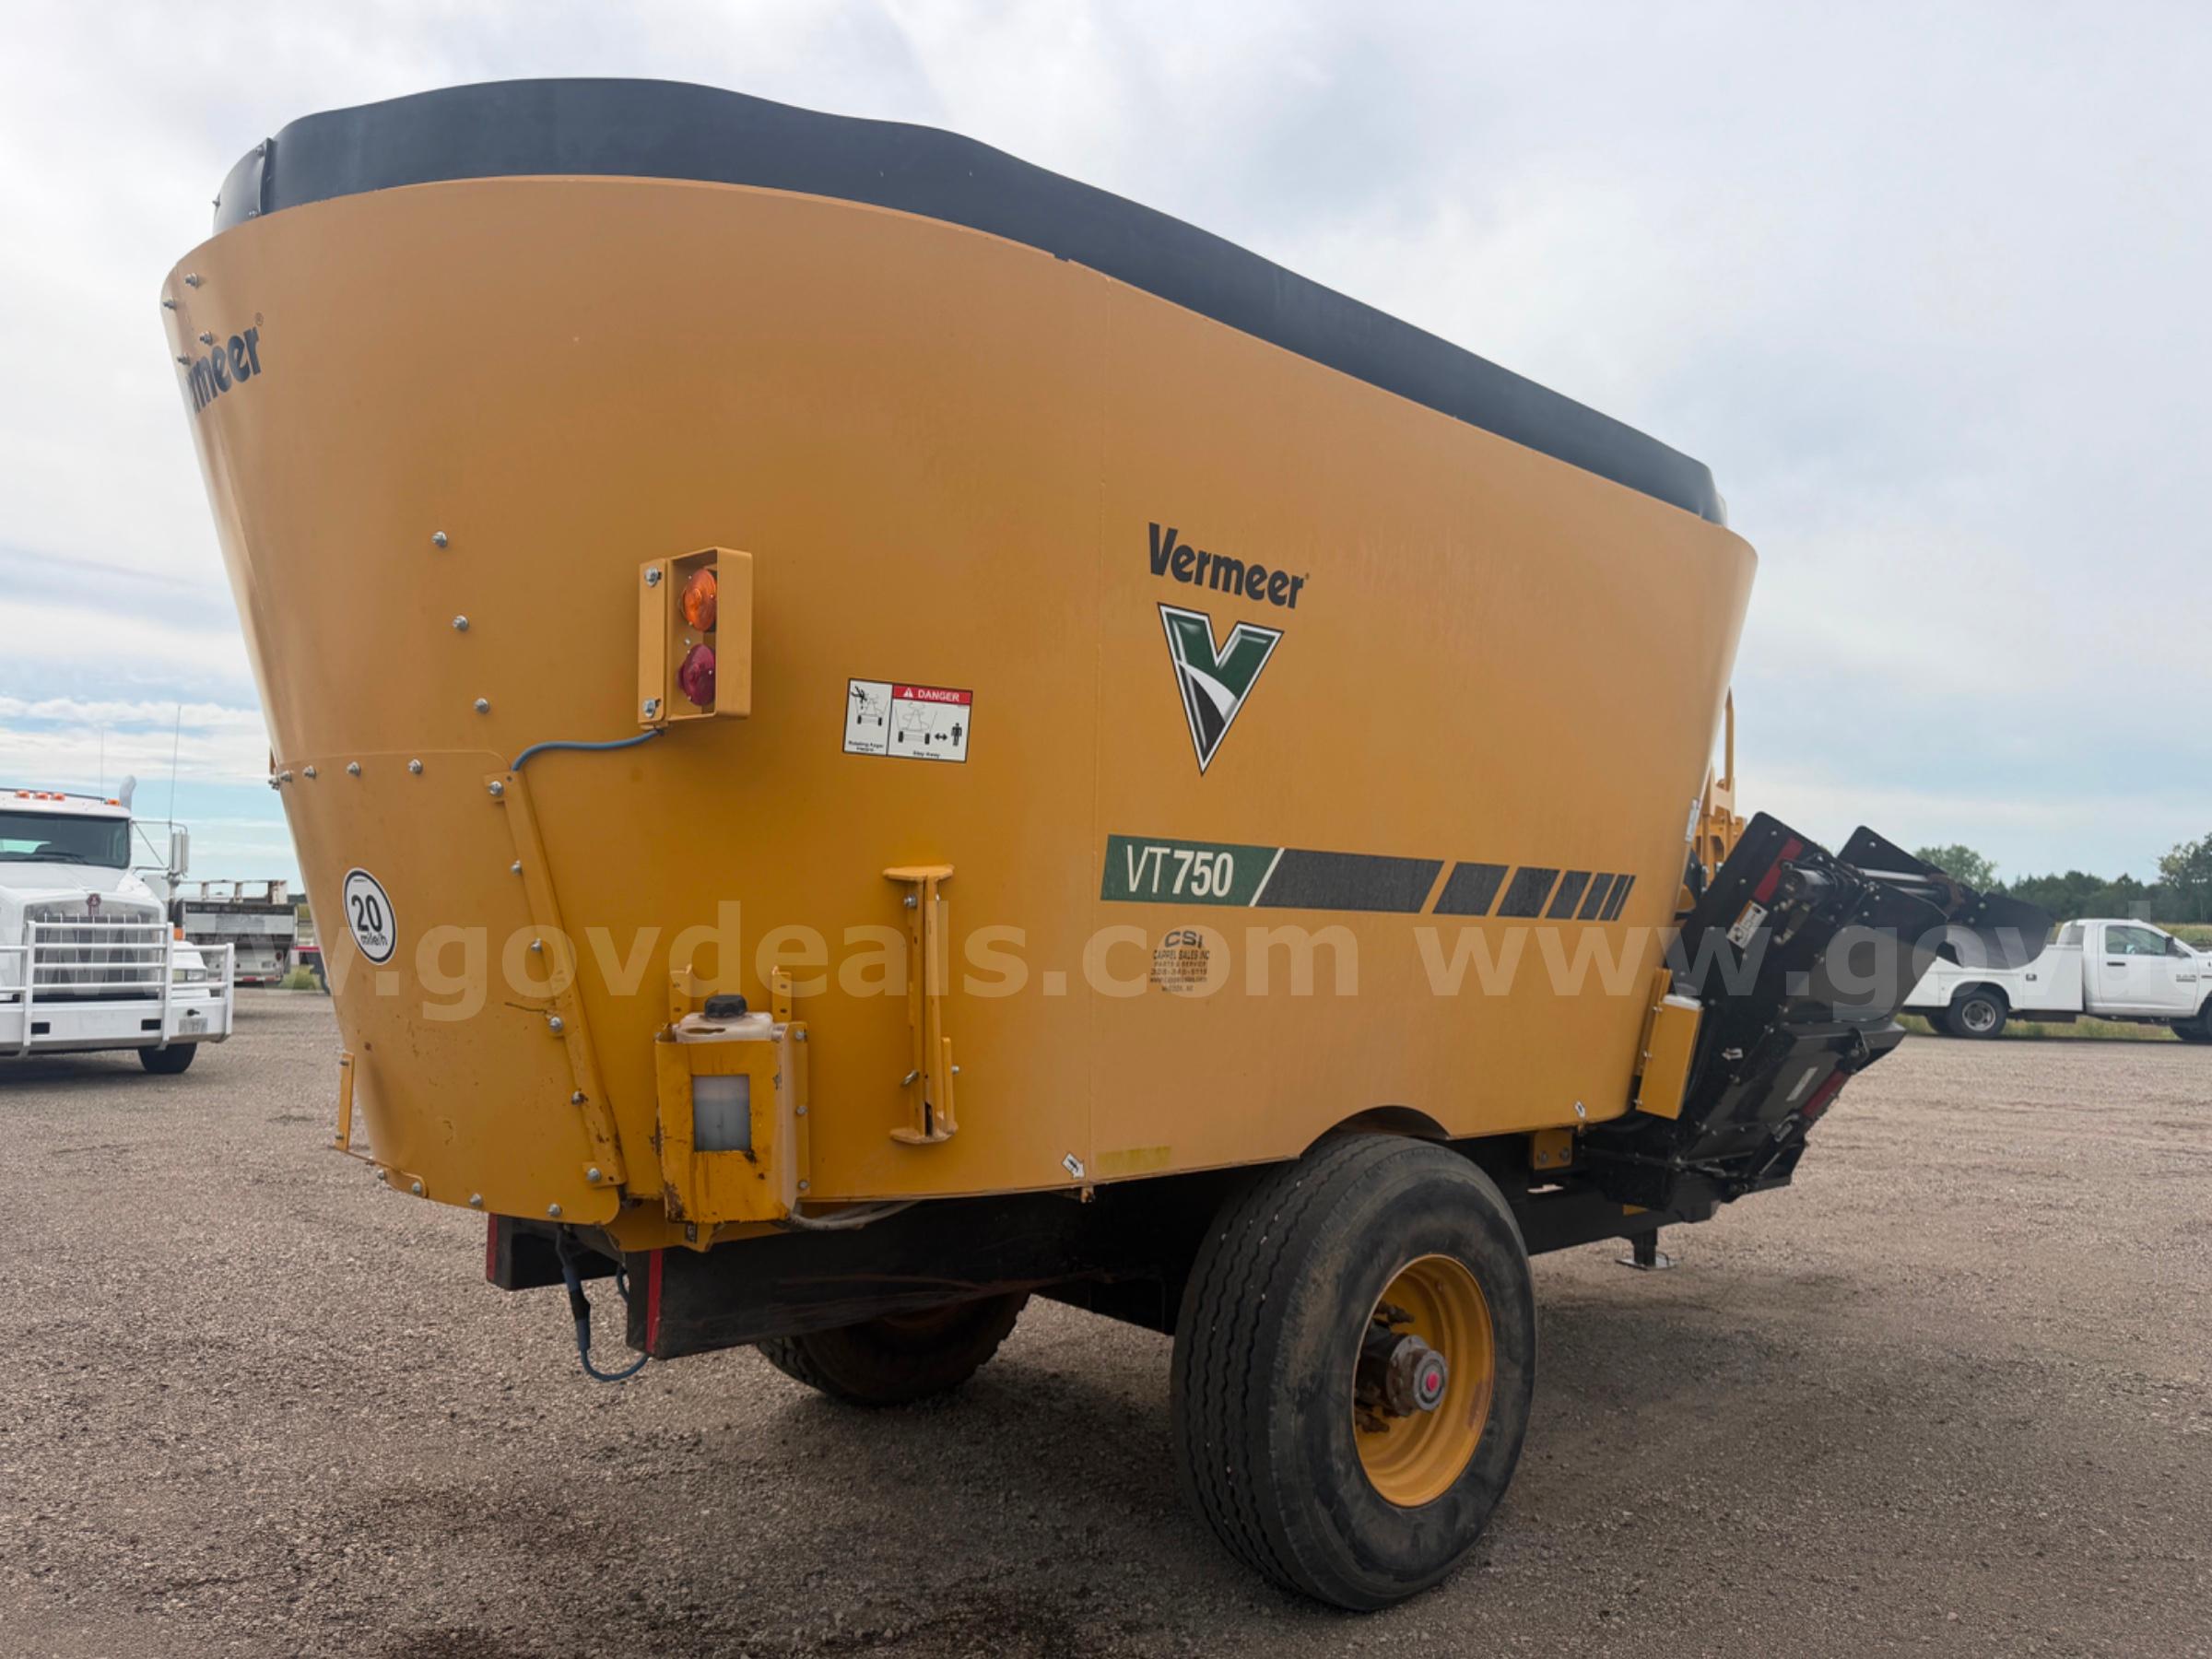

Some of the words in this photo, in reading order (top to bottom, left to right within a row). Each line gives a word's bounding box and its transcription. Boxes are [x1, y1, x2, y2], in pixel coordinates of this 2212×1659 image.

[1148, 522, 1304, 609] Vermeer
[917, 689, 959, 701] DANGER
[351, 894, 382, 933] 20
